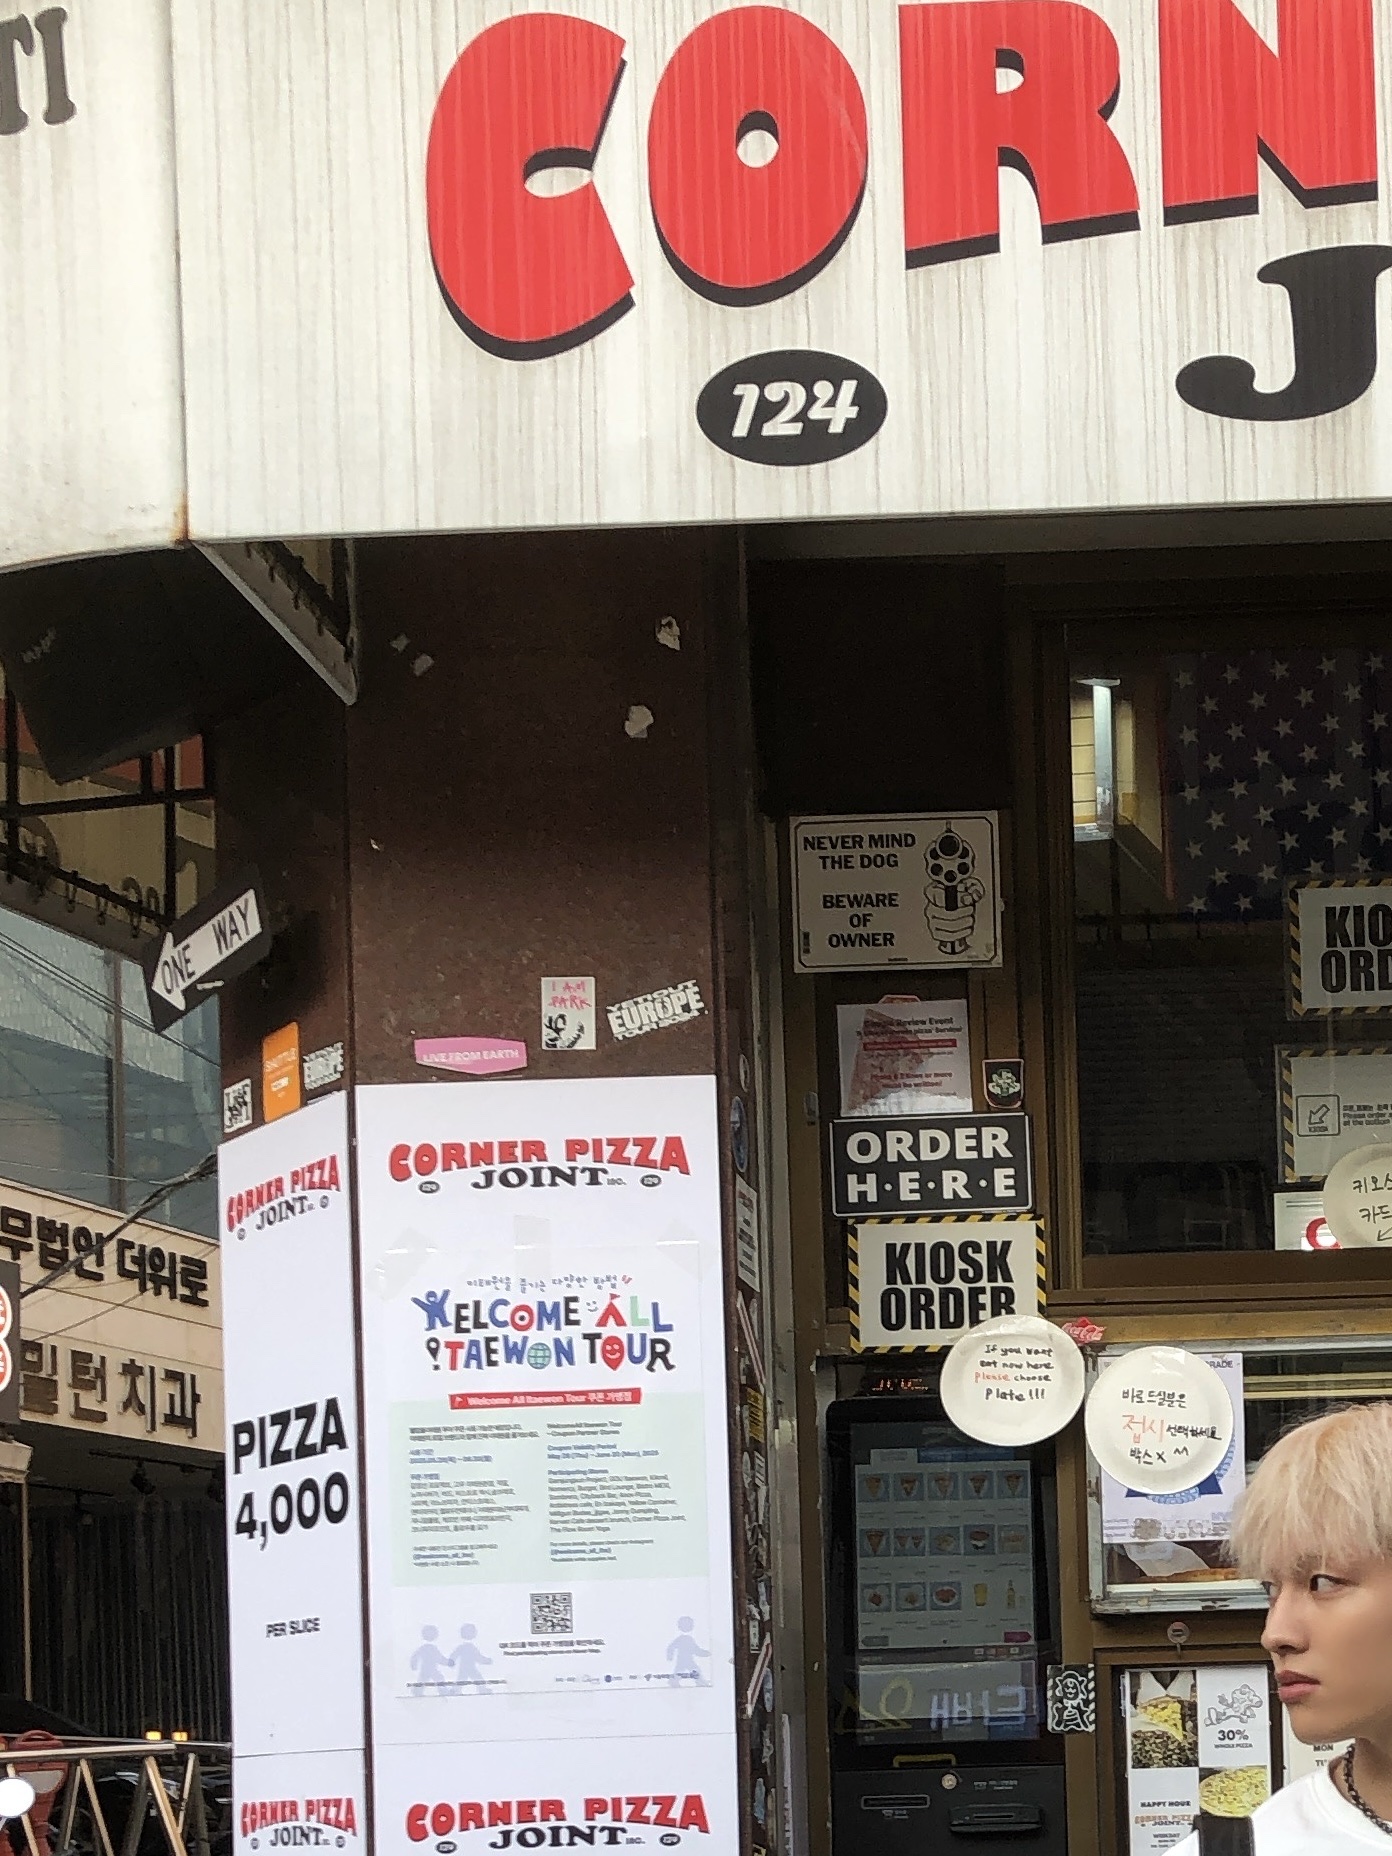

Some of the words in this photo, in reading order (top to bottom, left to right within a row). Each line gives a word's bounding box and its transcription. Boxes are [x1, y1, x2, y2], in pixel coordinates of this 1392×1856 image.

[729, 377, 860, 438] 124
[803, 834, 864, 851] NEVER
[868, 833, 916, 849] MIND
[819, 855, 854, 870] THE
[860, 853, 899, 869] DOG
[822, 893, 899, 909] BEWARE
[849, 913, 874, 928] OF
[160, 944, 196, 996] ONE
[211, 904, 255, 957] WAY
[828, 933, 895, 948] OWNER
[607, 986, 705, 1035] EUROPE
[449, 1051, 482, 1063] FROM
[482, 1049, 520, 1061] EARTH
[389, 1139, 548, 1182] CORNER
[565, 1136, 690, 1175] PIZZA
[846, 1126, 1014, 1164] ORDER
[227, 1176, 285, 1233] CORNER
[290, 1154, 341, 1193] PIZZA
[470, 1166, 608, 1189] JOINT
[256, 1195, 308, 1230] JOINT
[117, 1238, 209, 1307] 더위로
[885, 1240, 1014, 1286] KIOSK
[411, 1289, 582, 1334] WELCOME
[595, 1293, 674, 1333] ALL
[880, 1285, 1016, 1331] ORDER
[582, 1332, 677, 1373] TOUR
[979, 1359, 998, 1369] eat
[1002, 1360, 1024, 1369] now
[1026, 1359, 1054, 1370] here
[985, 1344, 998, 1355] If
[1000, 1345, 1022, 1357] you
[974, 1371, 1010, 1383] please
[1013, 1372, 1052, 1382] choose
[1121, 1388, 1145, 1405] 바로
[231, 1395, 349, 1477] PIZZA
[1121, 1414, 1165, 1444] 접시
[1129, 1447, 1153, 1465] 박스
[234, 1470, 351, 1552] 4,000
[266, 1619, 289, 1638] PER
[291, 1616, 321, 1637] SLICE
[241, 1799, 300, 1838] CORNER
[305, 1797, 357, 1837] PIZZA
[406, 1799, 567, 1842] CORNER
[584, 1795, 710, 1834] PIZZA
[269, 1825, 324, 1847] JOINT
[489, 1825, 627, 1849] JOINT
